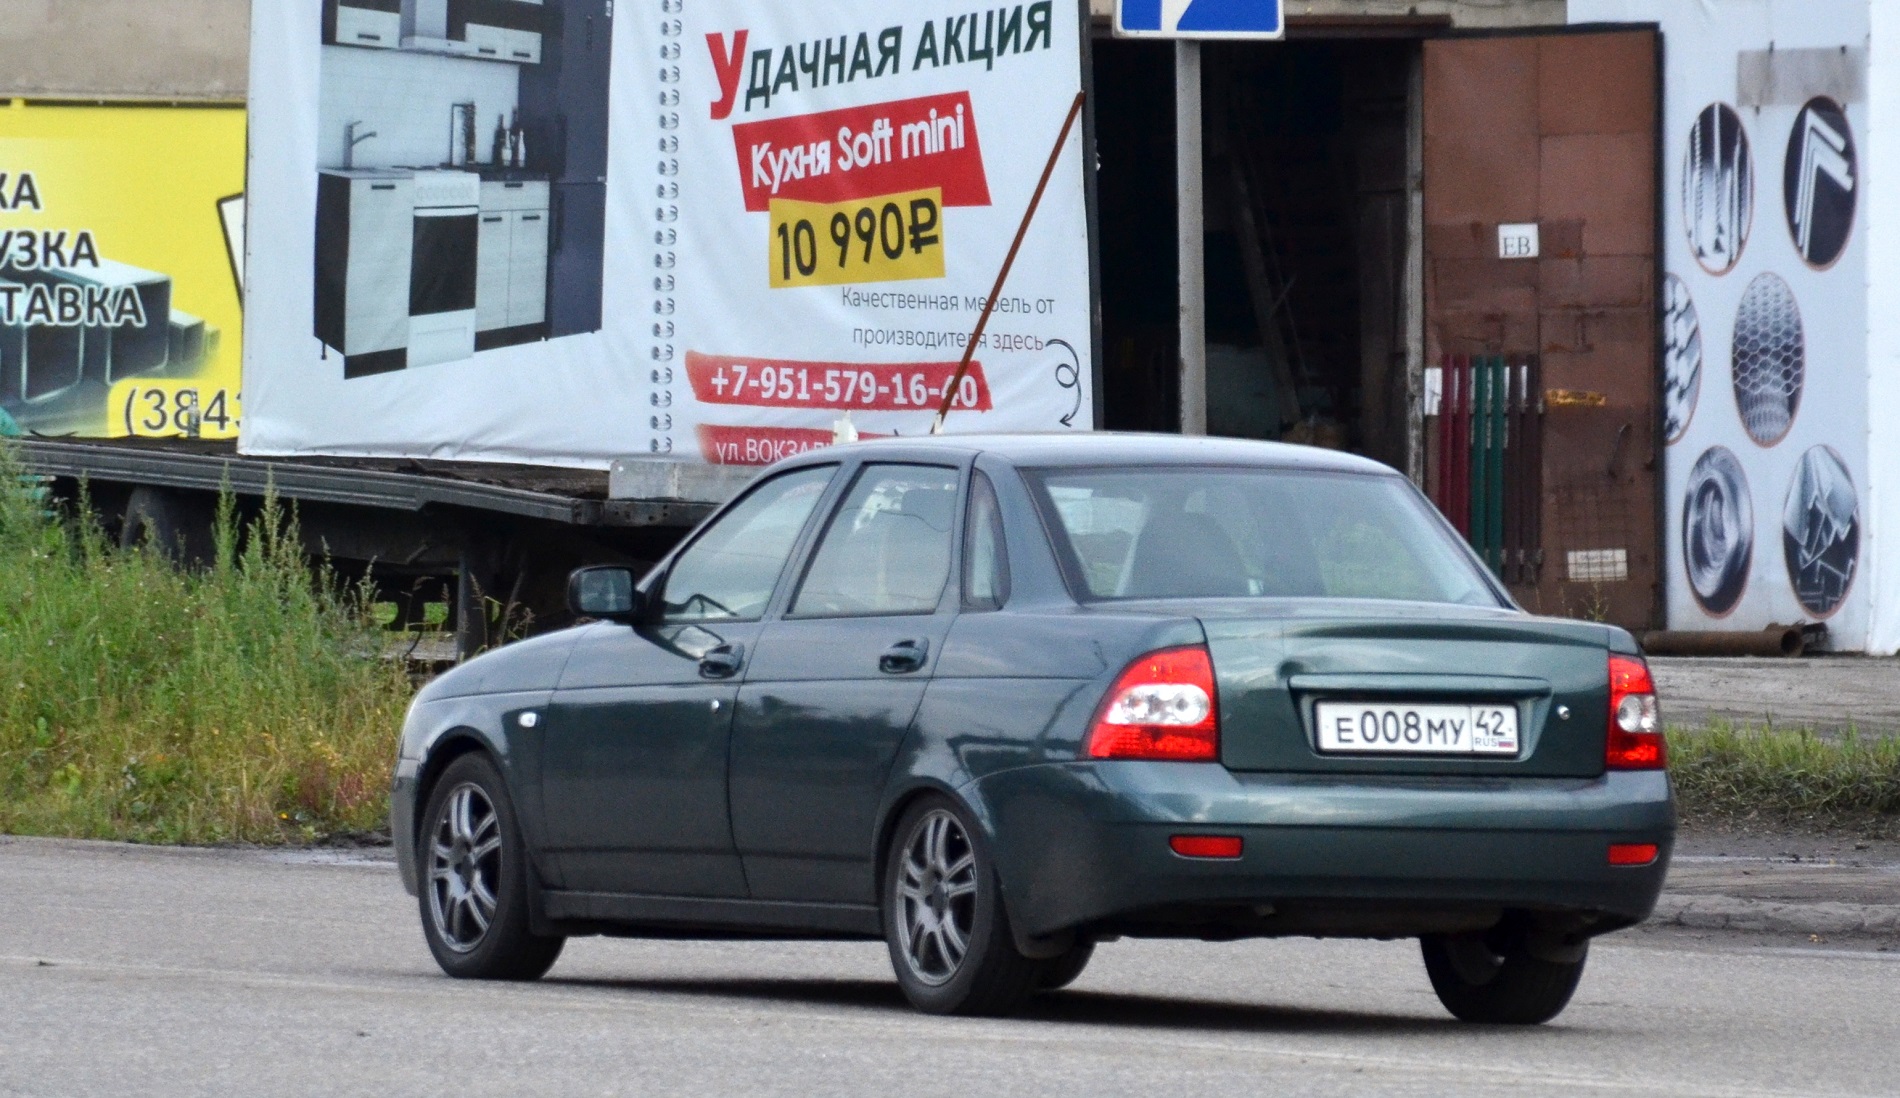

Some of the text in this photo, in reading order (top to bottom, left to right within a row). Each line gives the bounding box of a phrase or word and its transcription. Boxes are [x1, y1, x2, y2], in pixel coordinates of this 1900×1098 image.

[705, 0, 1053, 120] УДАЧНАЯ АКЦИЯ
[751, 103, 965, 194] Кухня Soft mini
[777, 197, 939, 281] 10 990₽
[842, 286, 959, 311] Качественная
[1036, 298, 1055, 314] от
[993, 333, 1044, 352] здесь
[125, 387, 241, 436] (384
[1336, 710, 1506, 745] Е008МУ 42
[1474, 737, 1498, 748] RUS
